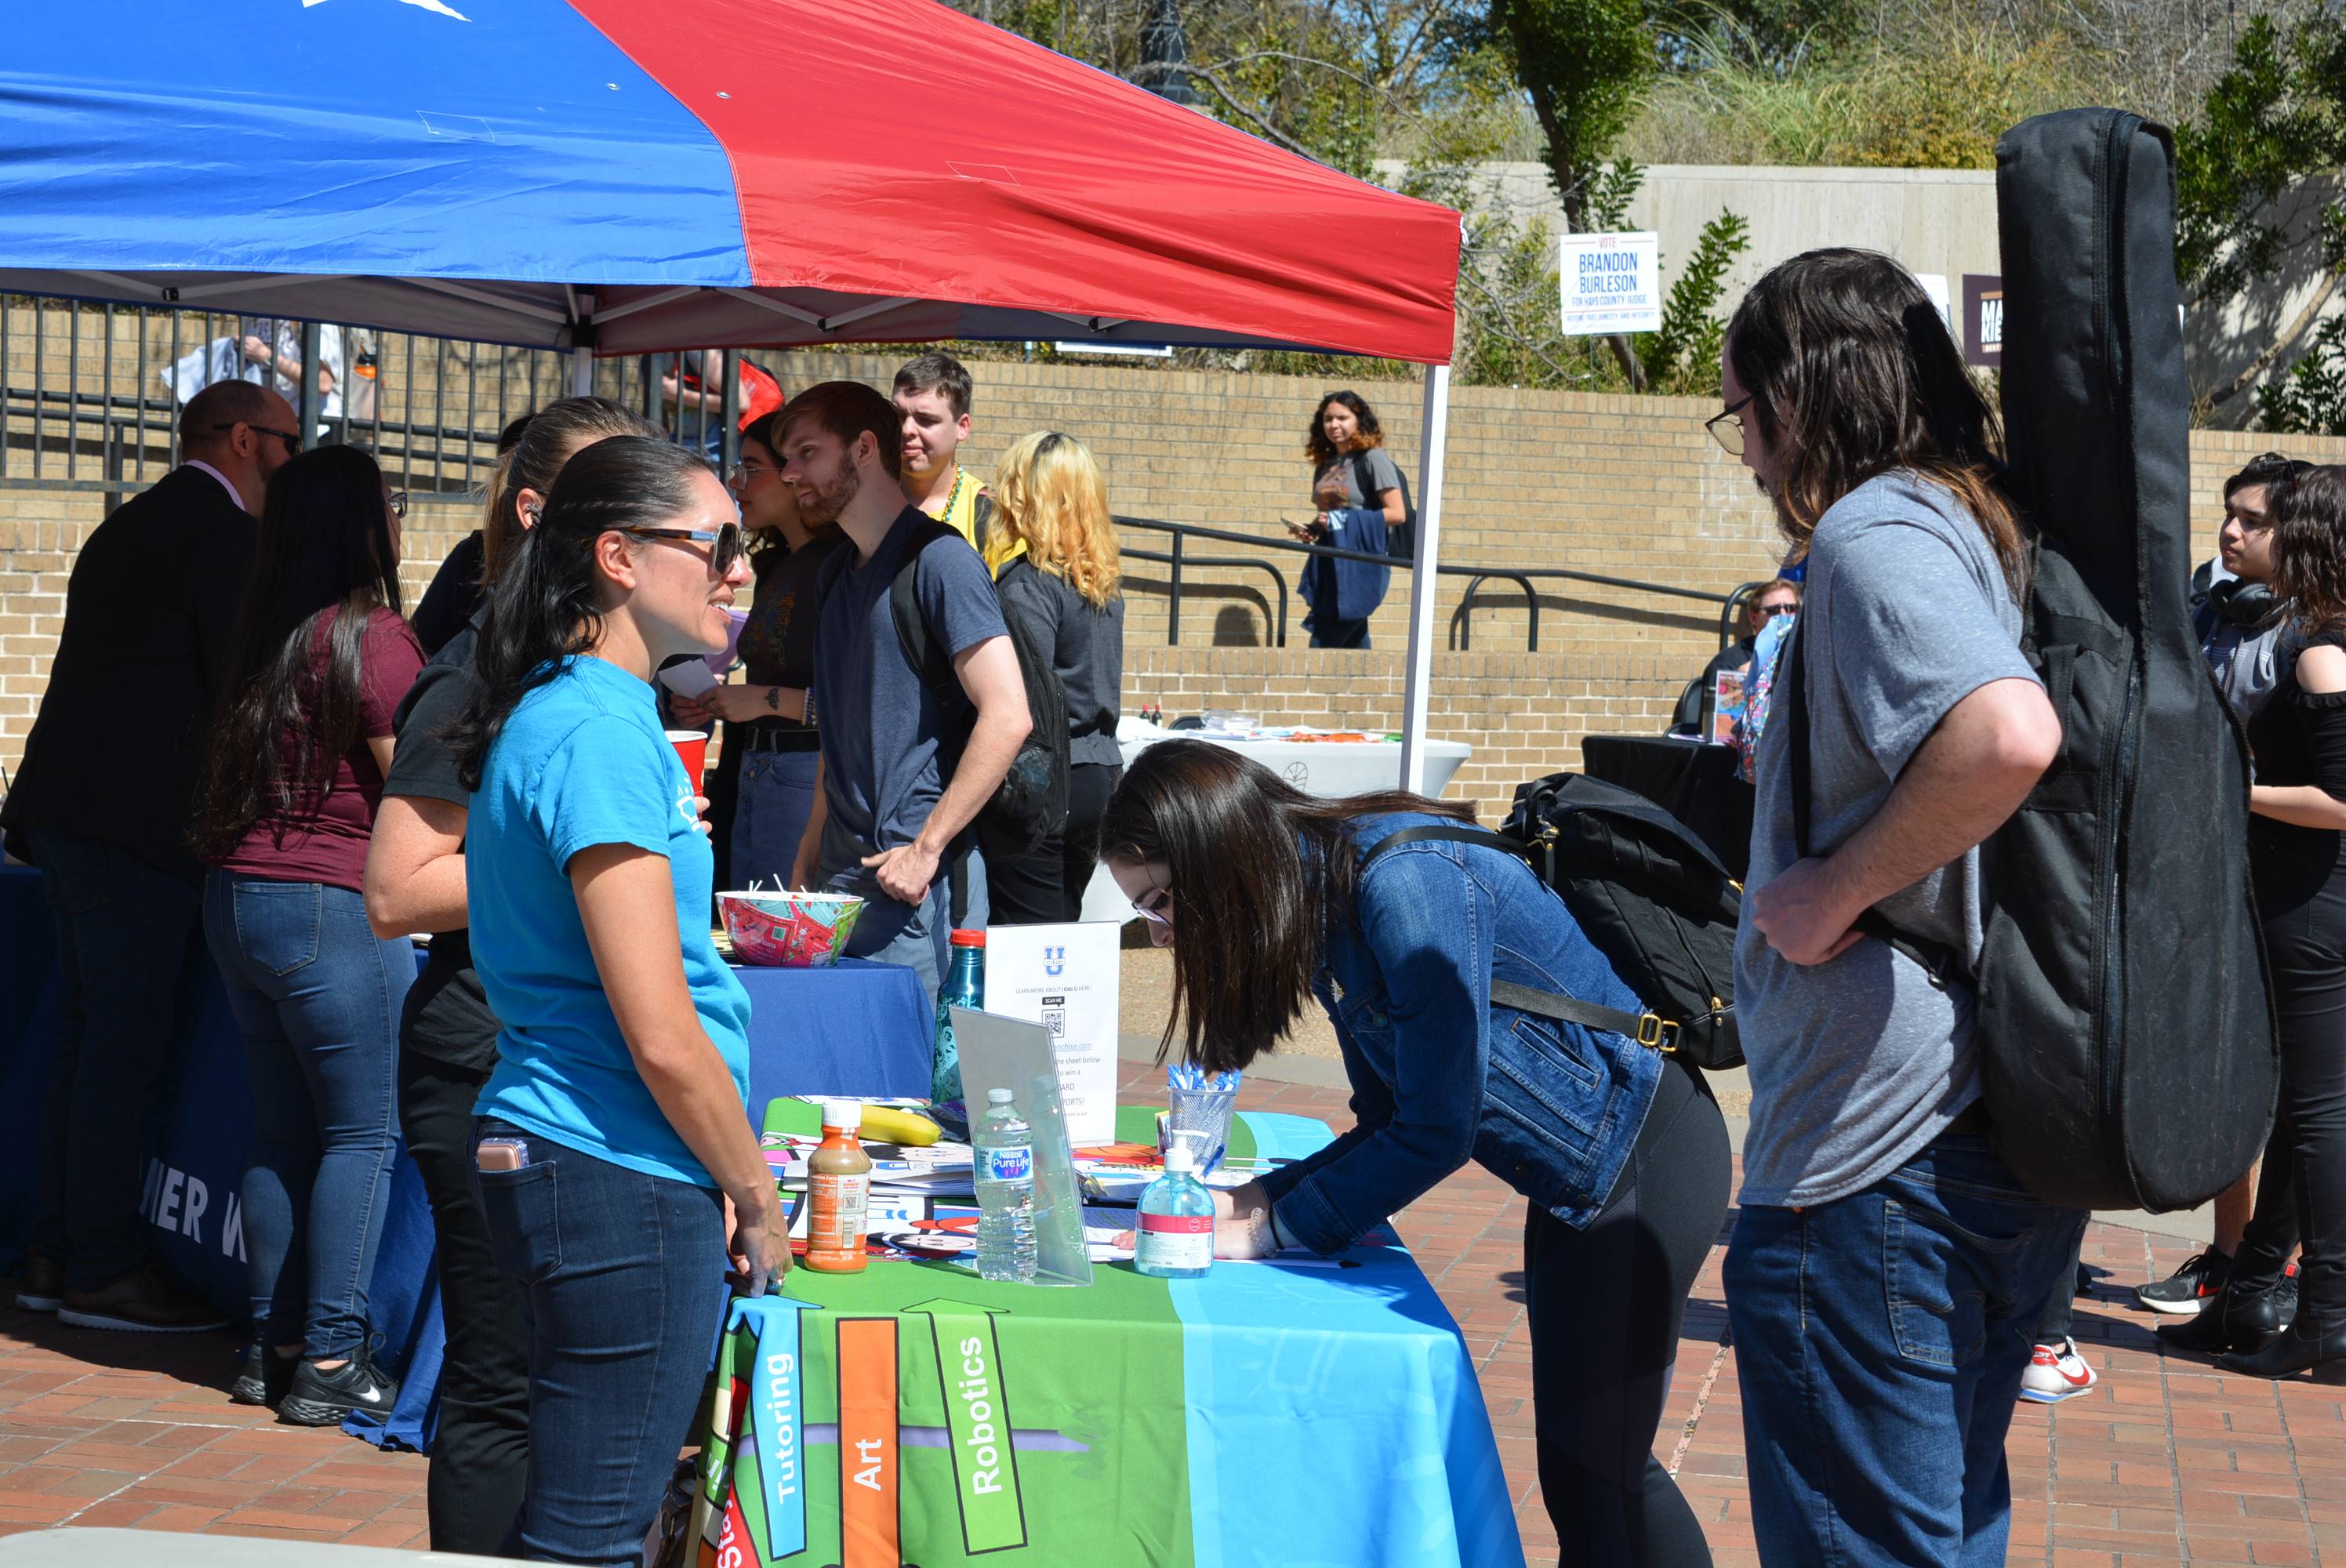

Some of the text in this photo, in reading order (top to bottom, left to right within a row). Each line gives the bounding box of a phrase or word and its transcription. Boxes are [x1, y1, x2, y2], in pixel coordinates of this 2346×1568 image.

[1599, 237, 1617, 249] VOTE
[1579, 252, 1638, 273] BRANDON
[1580, 274, 1637, 294] BURLESON
[1572, 294, 1647, 307] FOR HAYS COUNTY JUDGE
[1981, 299, 2003, 321] MA
[1631, 310, 1655, 319] INTEGRITY
[1981, 320, 2002, 343] KIE
[993, 1159, 1015, 1168] Pure
[1016, 1157, 1030, 1170] Life
[999, 1150, 1023, 1159] Nestlé
[959, 1336, 1003, 1496] Robotics
[766, 1352, 795, 1504] Tutoring
[853, 1438, 883, 1492] Art
